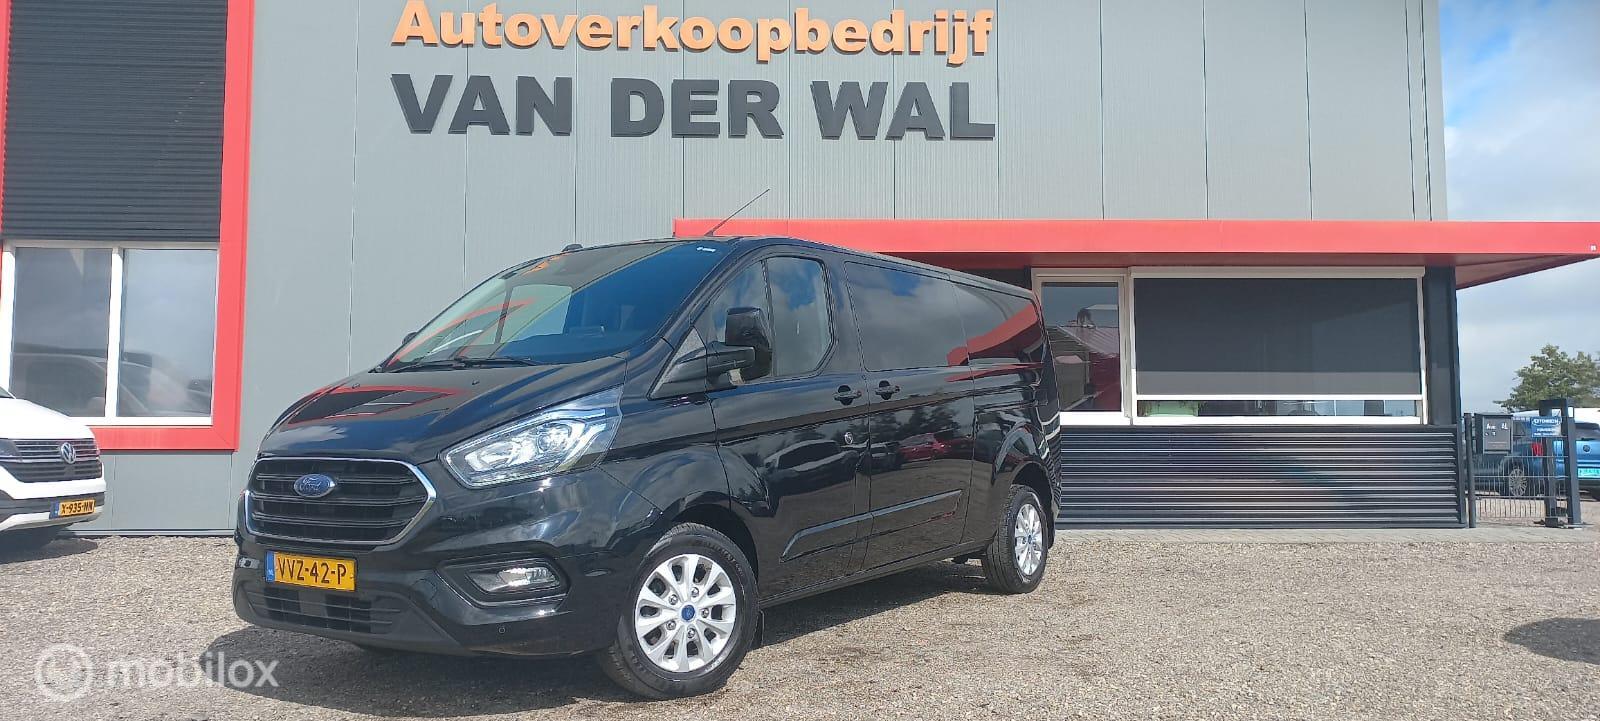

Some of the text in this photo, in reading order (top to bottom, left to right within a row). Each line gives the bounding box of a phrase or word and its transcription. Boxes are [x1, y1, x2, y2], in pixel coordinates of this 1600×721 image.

[391, 0, 993, 66] Autoverkoopbedrijf
[390, 74, 996, 141] VAN DER WAL
[277, 557, 347, 585] VVZ-42-P
